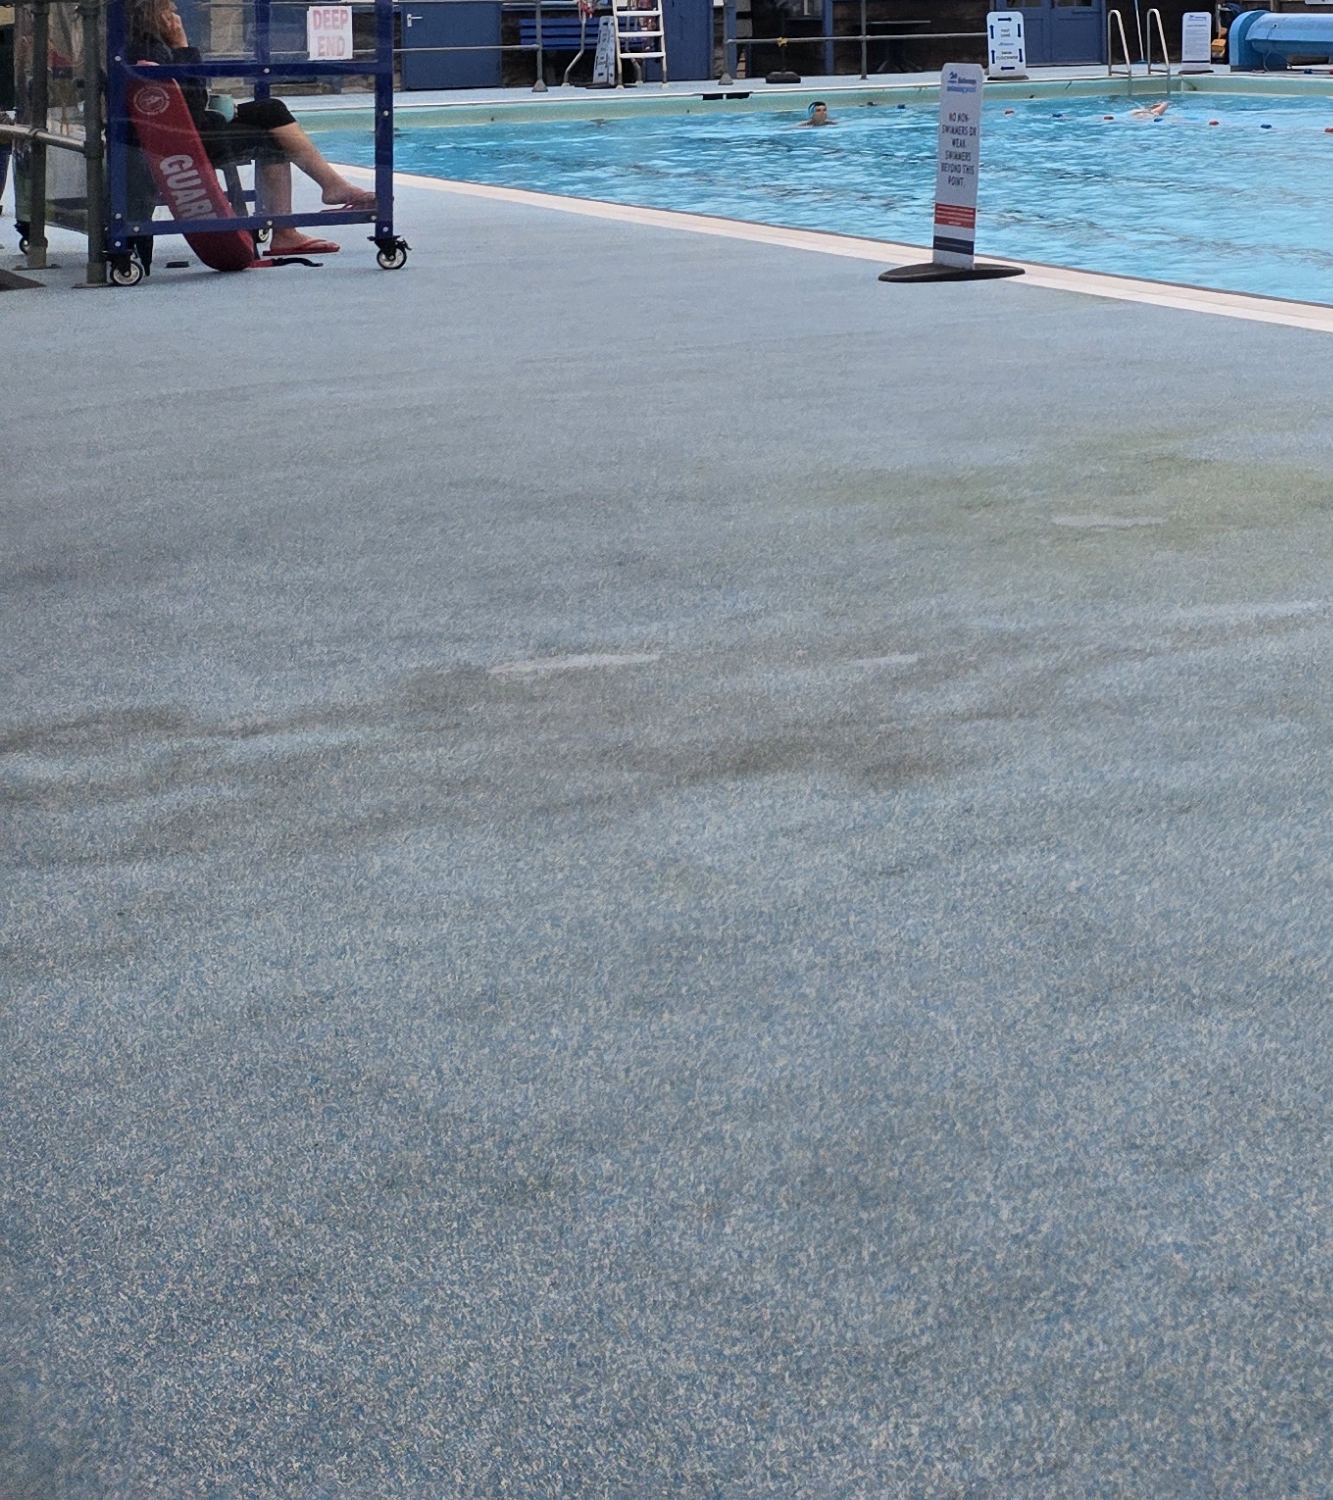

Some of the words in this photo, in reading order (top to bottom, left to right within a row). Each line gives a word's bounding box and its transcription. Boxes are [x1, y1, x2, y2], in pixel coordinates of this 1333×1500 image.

[312, 9, 349, 30] DEEP
[317, 35, 346, 57] END
[948, 112, 956, 122] NO
[957, 112, 971, 123] NON-
[941, 124, 968, 136] SWIMMERS
[969, 126, 977, 137] OR
[951, 138, 966, 149] WEAK
[945, 150, 972, 162] SWIMMERS
[941, 162, 962, 174] BEYOND
[962, 164, 975, 175] THIS
[159, 154, 218, 219] GUAR
